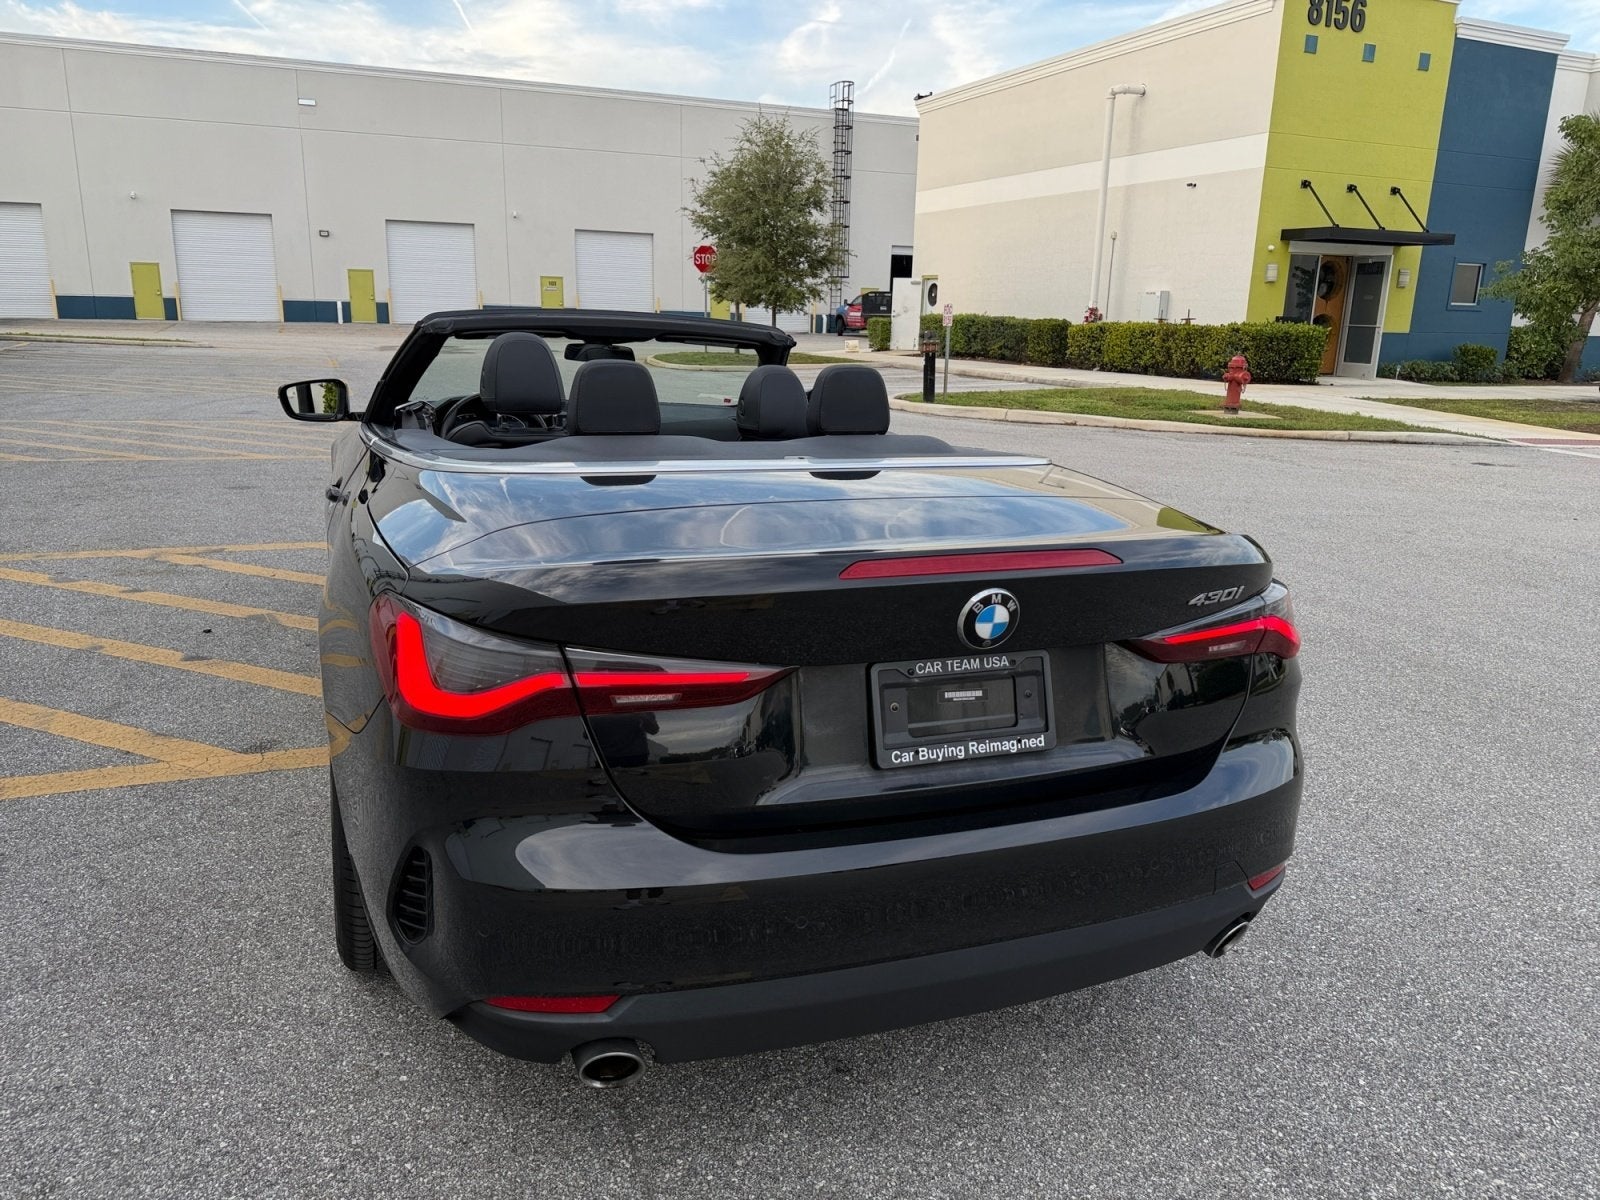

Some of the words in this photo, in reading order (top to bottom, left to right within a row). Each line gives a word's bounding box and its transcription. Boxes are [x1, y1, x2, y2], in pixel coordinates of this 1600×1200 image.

[1308, 0, 1367, 33] 8156
[972, 593, 1017, 614] BMW
[1188, 585, 1245, 607] 430i
[915, 661, 942, 674] CAR
[946, 658, 980, 672] TEAM
[984, 656, 1010, 668] USA
[891, 750, 914, 763] Car
[918, 744, 965, 762] Buying
